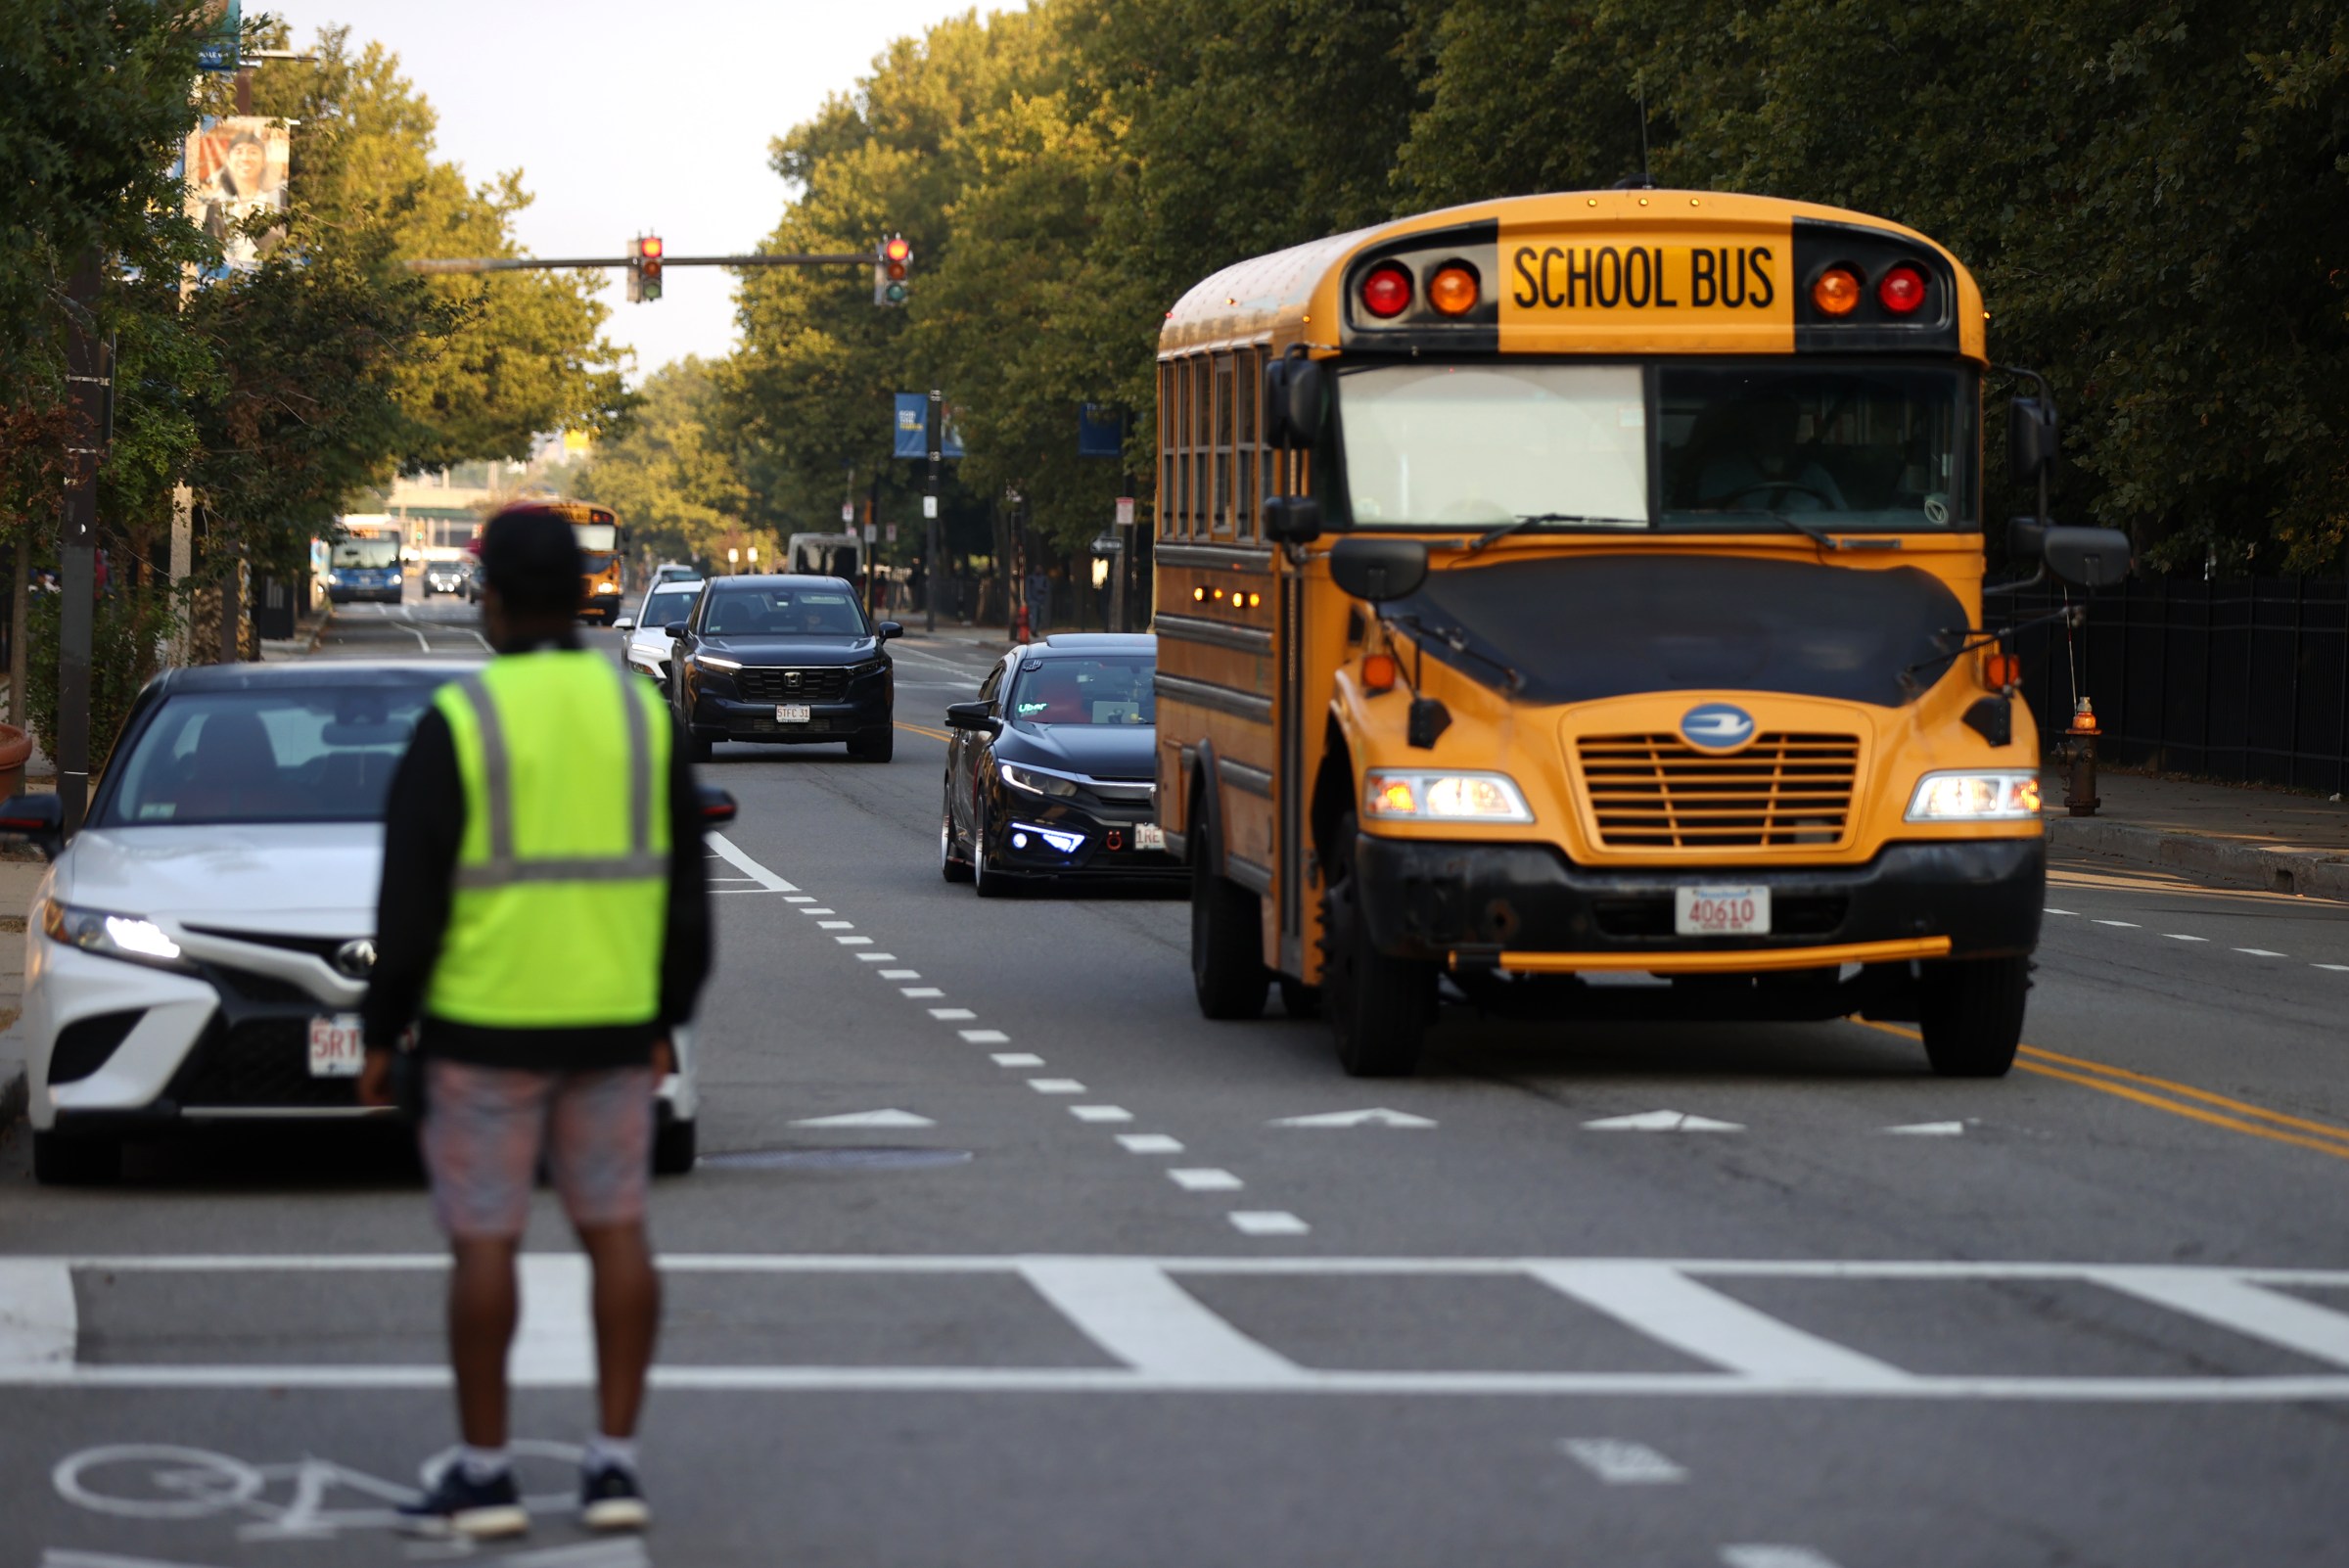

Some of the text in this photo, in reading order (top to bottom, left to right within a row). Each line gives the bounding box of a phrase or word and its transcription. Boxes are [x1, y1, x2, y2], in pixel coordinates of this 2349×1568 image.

[1513, 247, 1774, 308] SCHOOL BUS
[777, 708, 808, 718] 5TFC 31
[1018, 703, 1047, 714] Uber
[1688, 899, 1755, 923] 40610
